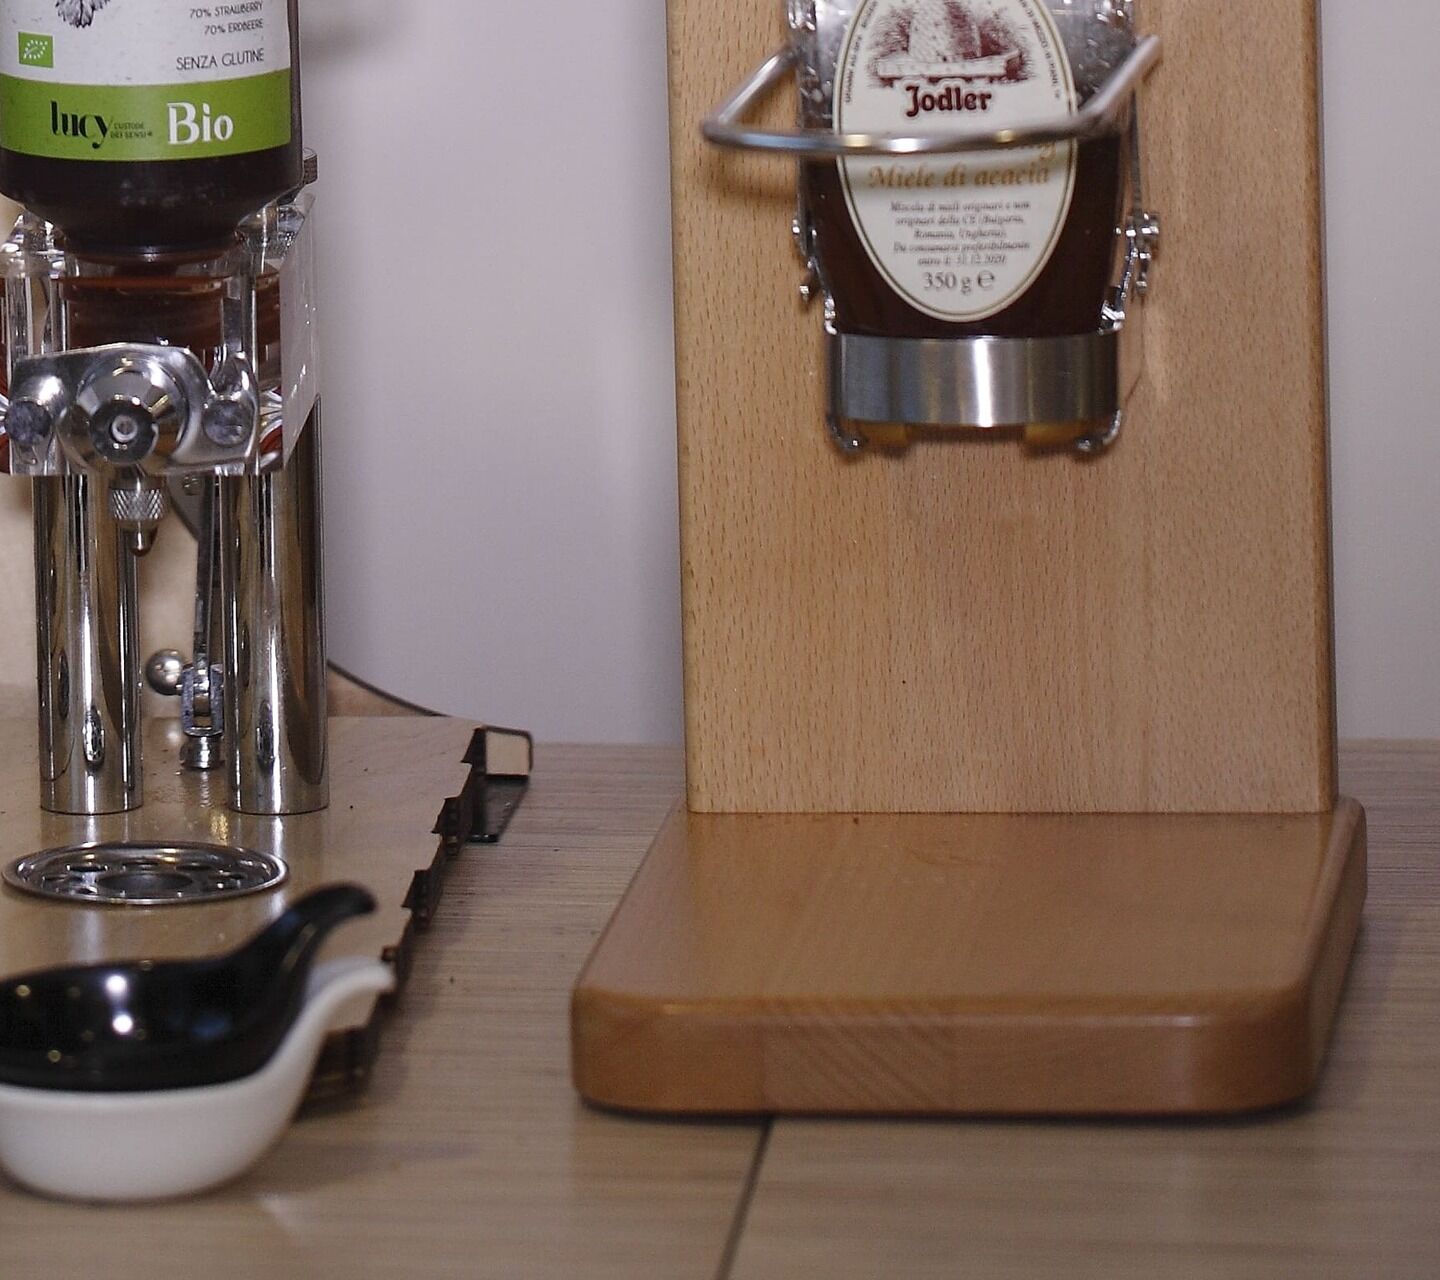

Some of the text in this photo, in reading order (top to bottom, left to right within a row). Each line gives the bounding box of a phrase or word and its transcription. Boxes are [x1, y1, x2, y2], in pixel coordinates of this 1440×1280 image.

[190, 0, 263, 18] 70% STRAWBERRY
[204, 18, 263, 35] 70% ERDBEERE
[176, 48, 264, 70] SENZA GLUTINE
[905, 85, 992, 117] Jodler
[50, 100, 234, 149] lucy Bio
[869, 161, 1050, 188] Miele di acacia
[923, 271, 957, 290] 350
[961, 279, 972, 295] g
